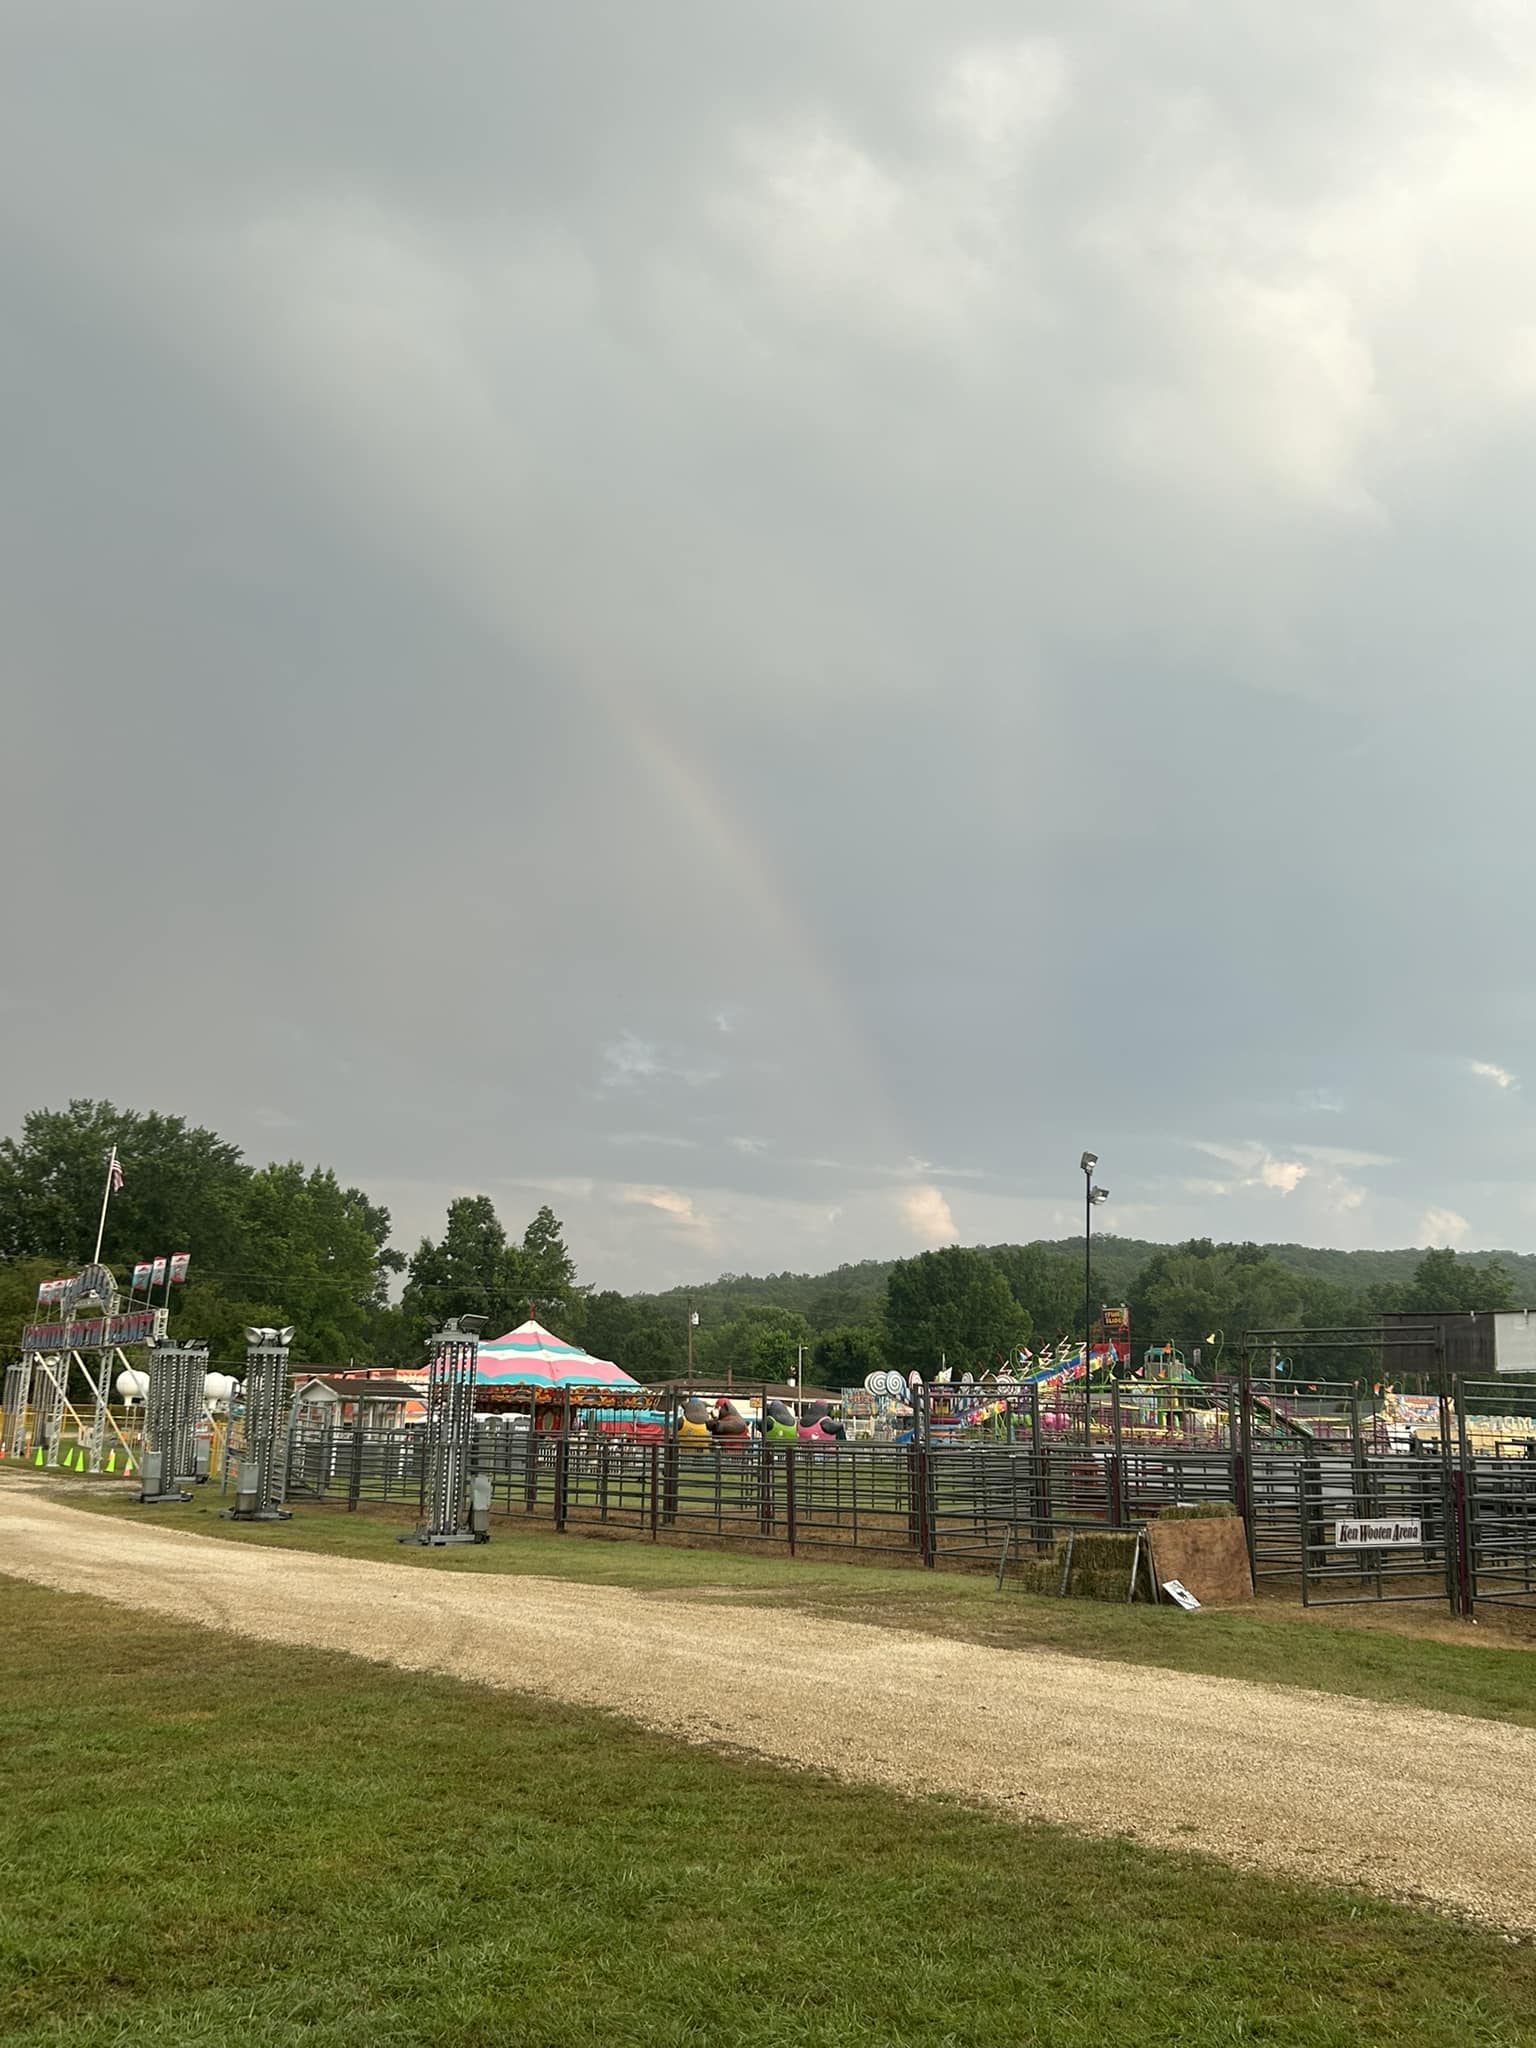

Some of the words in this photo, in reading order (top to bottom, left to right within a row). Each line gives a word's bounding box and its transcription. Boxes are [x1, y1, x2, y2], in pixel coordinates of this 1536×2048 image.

[1340, 1525, 1359, 1542] Ken
[1360, 1524, 1392, 1542] Wooten
[1392, 1524, 1418, 1541] Arena
